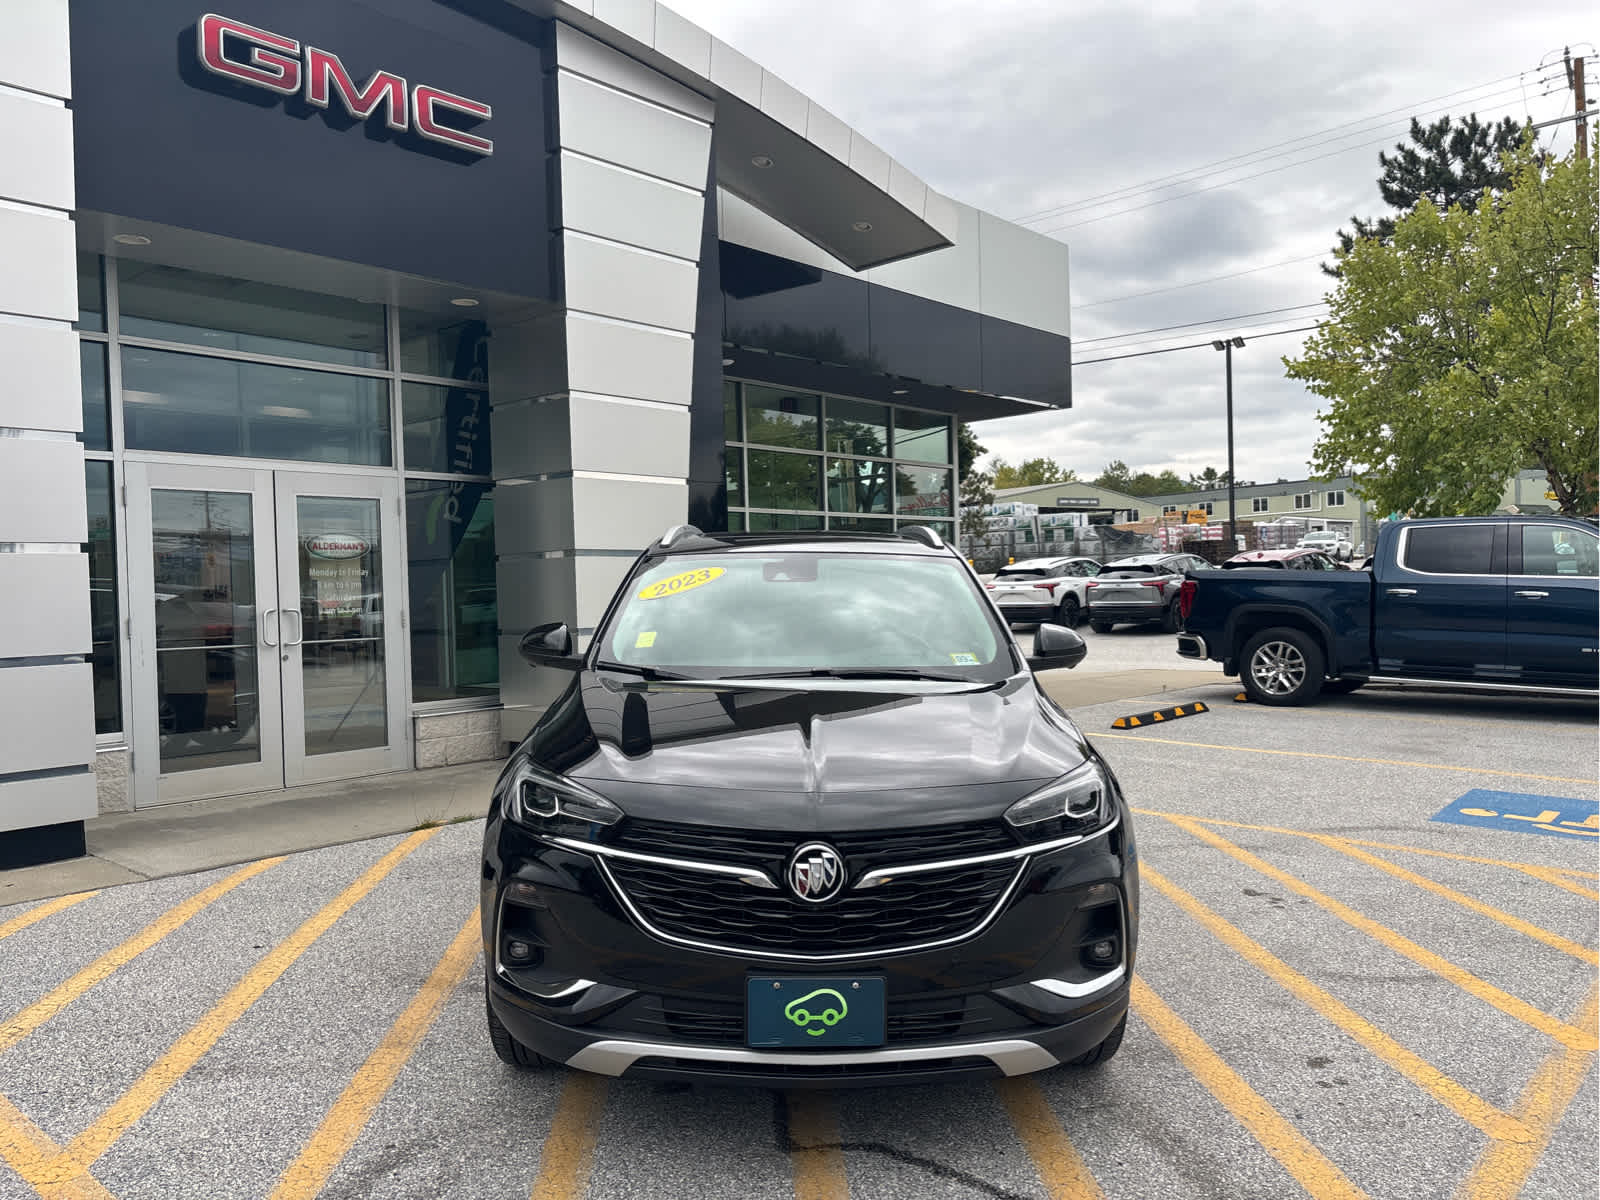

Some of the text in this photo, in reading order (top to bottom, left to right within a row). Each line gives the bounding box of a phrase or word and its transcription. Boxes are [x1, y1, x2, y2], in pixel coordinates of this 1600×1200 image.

[199, 13, 494, 156] GMC
[309, 567, 337, 577] Monday
[347, 567, 368, 577] Friday
[654, 570, 711, 596] 2023
